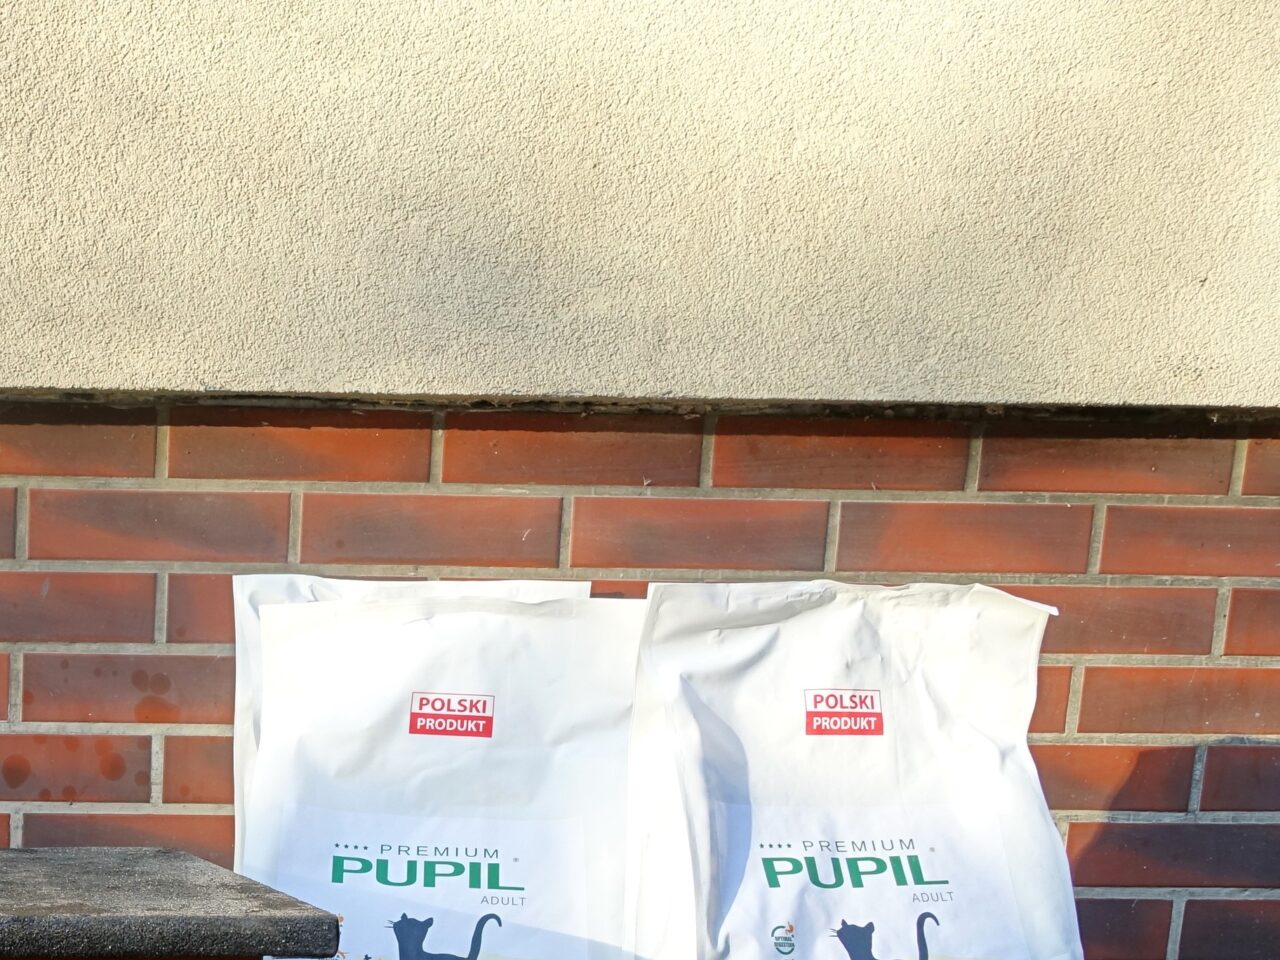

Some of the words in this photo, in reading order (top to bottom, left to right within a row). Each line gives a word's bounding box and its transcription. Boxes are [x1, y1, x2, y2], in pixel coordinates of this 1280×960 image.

[418, 697, 487, 714] POLSKI
[813, 694, 874, 710] POLSKI
[416, 717, 486, 732] PRODUKT
[813, 716, 877, 730] PRODUKT
[380, 844, 499, 859] PREMIUM
[802, 838, 916, 852] PREMIUM
[331, 855, 525, 891] PUPIL
[761, 855, 949, 888] PUPIL
[481, 895, 527, 907] ADULT
[912, 891, 954, 903] ADULT
